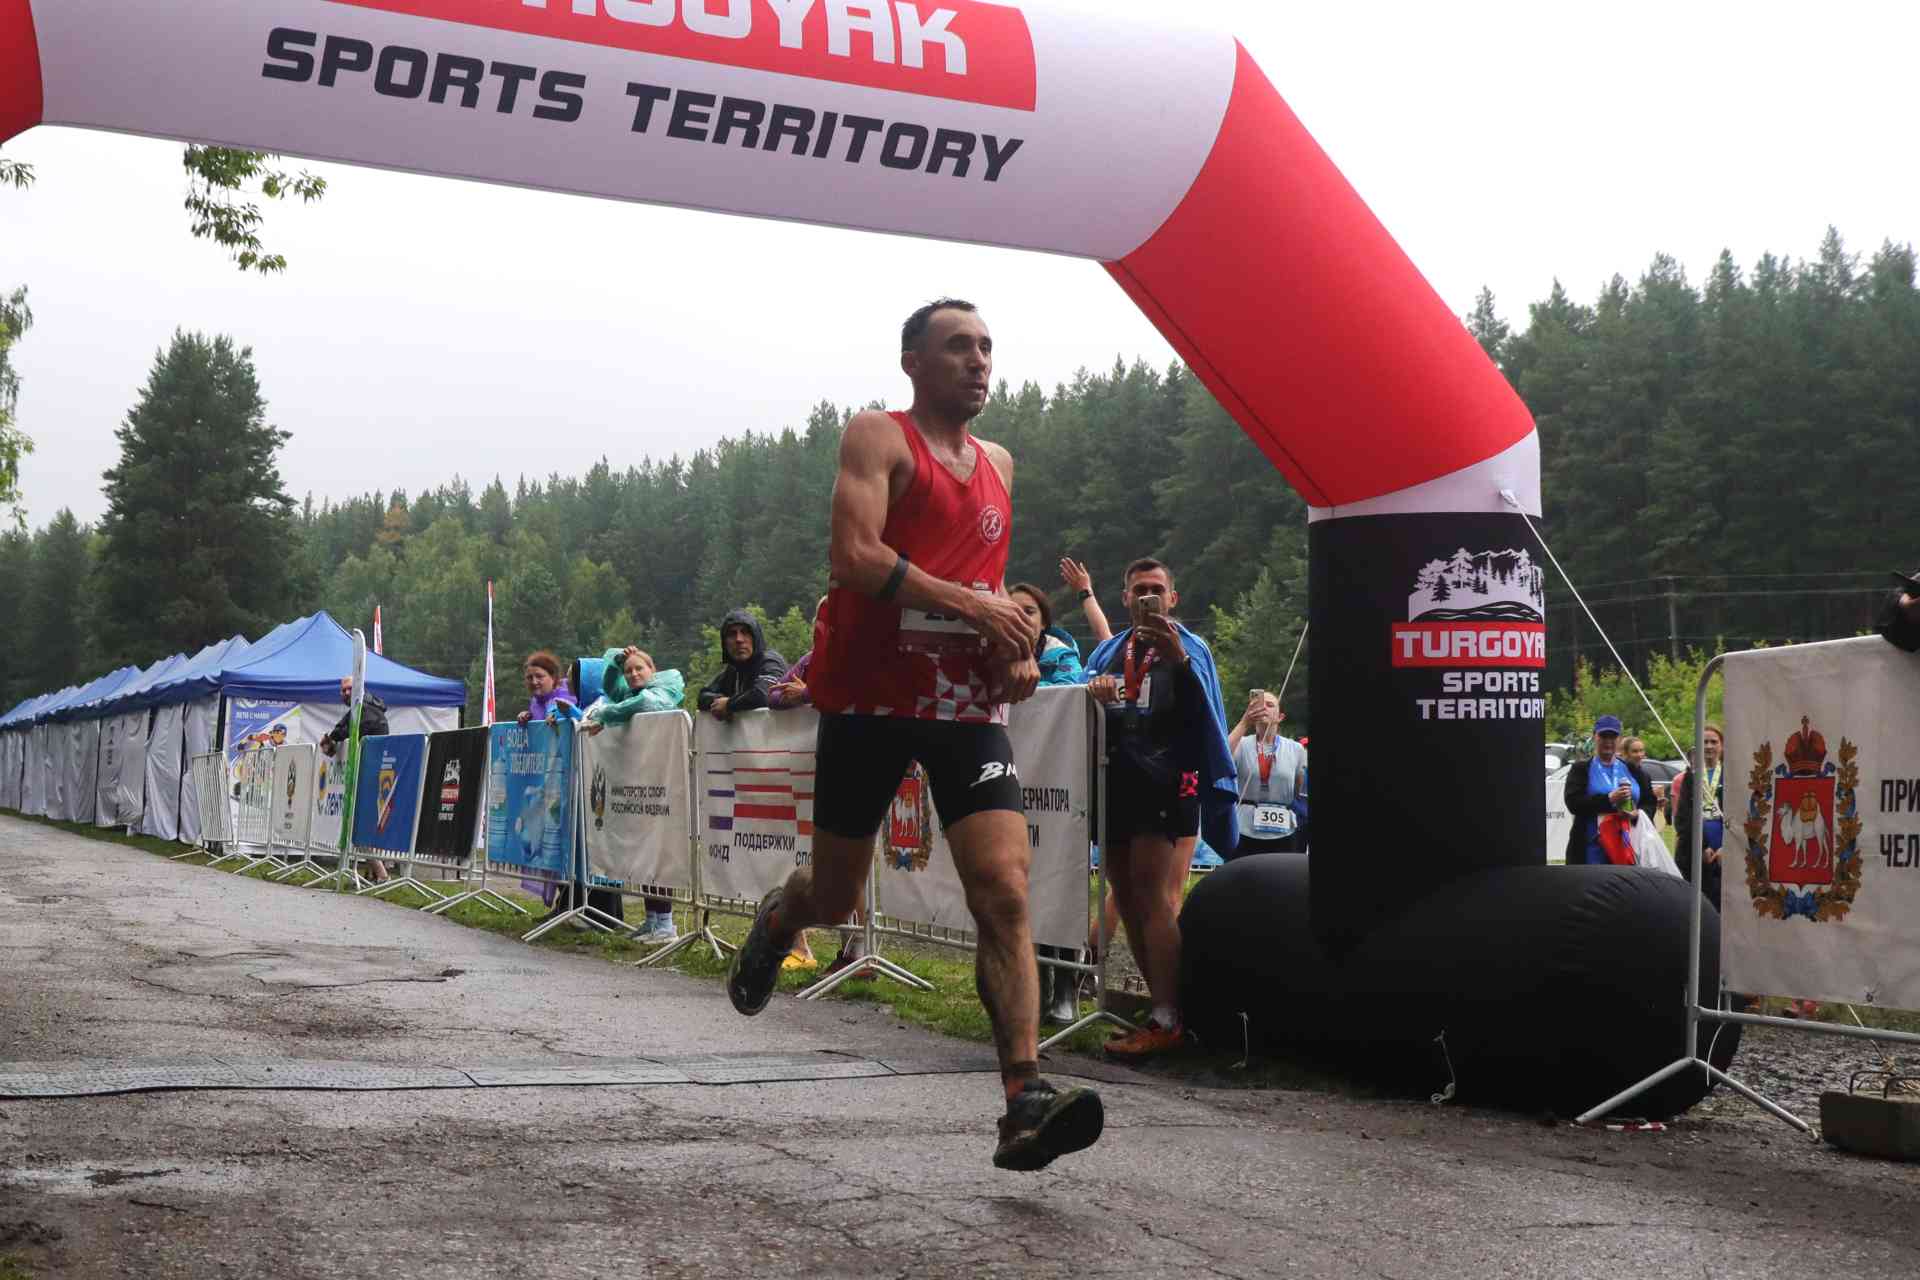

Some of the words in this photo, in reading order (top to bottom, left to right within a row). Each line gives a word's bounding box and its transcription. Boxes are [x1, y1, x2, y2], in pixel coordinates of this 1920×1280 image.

[521, 0, 967, 75] OYAK
[262, 27, 587, 123] SPORTS
[625, 82, 1024, 182] TERRITORY
[1395, 630, 1545, 659] TURGOYA
[1443, 671, 1539, 693] SPORTS
[1416, 698, 1545, 719] TERRITORY
[1022, 787, 1070, 812] ЕРНАТОРА
[1261, 811, 1285, 824] 305
